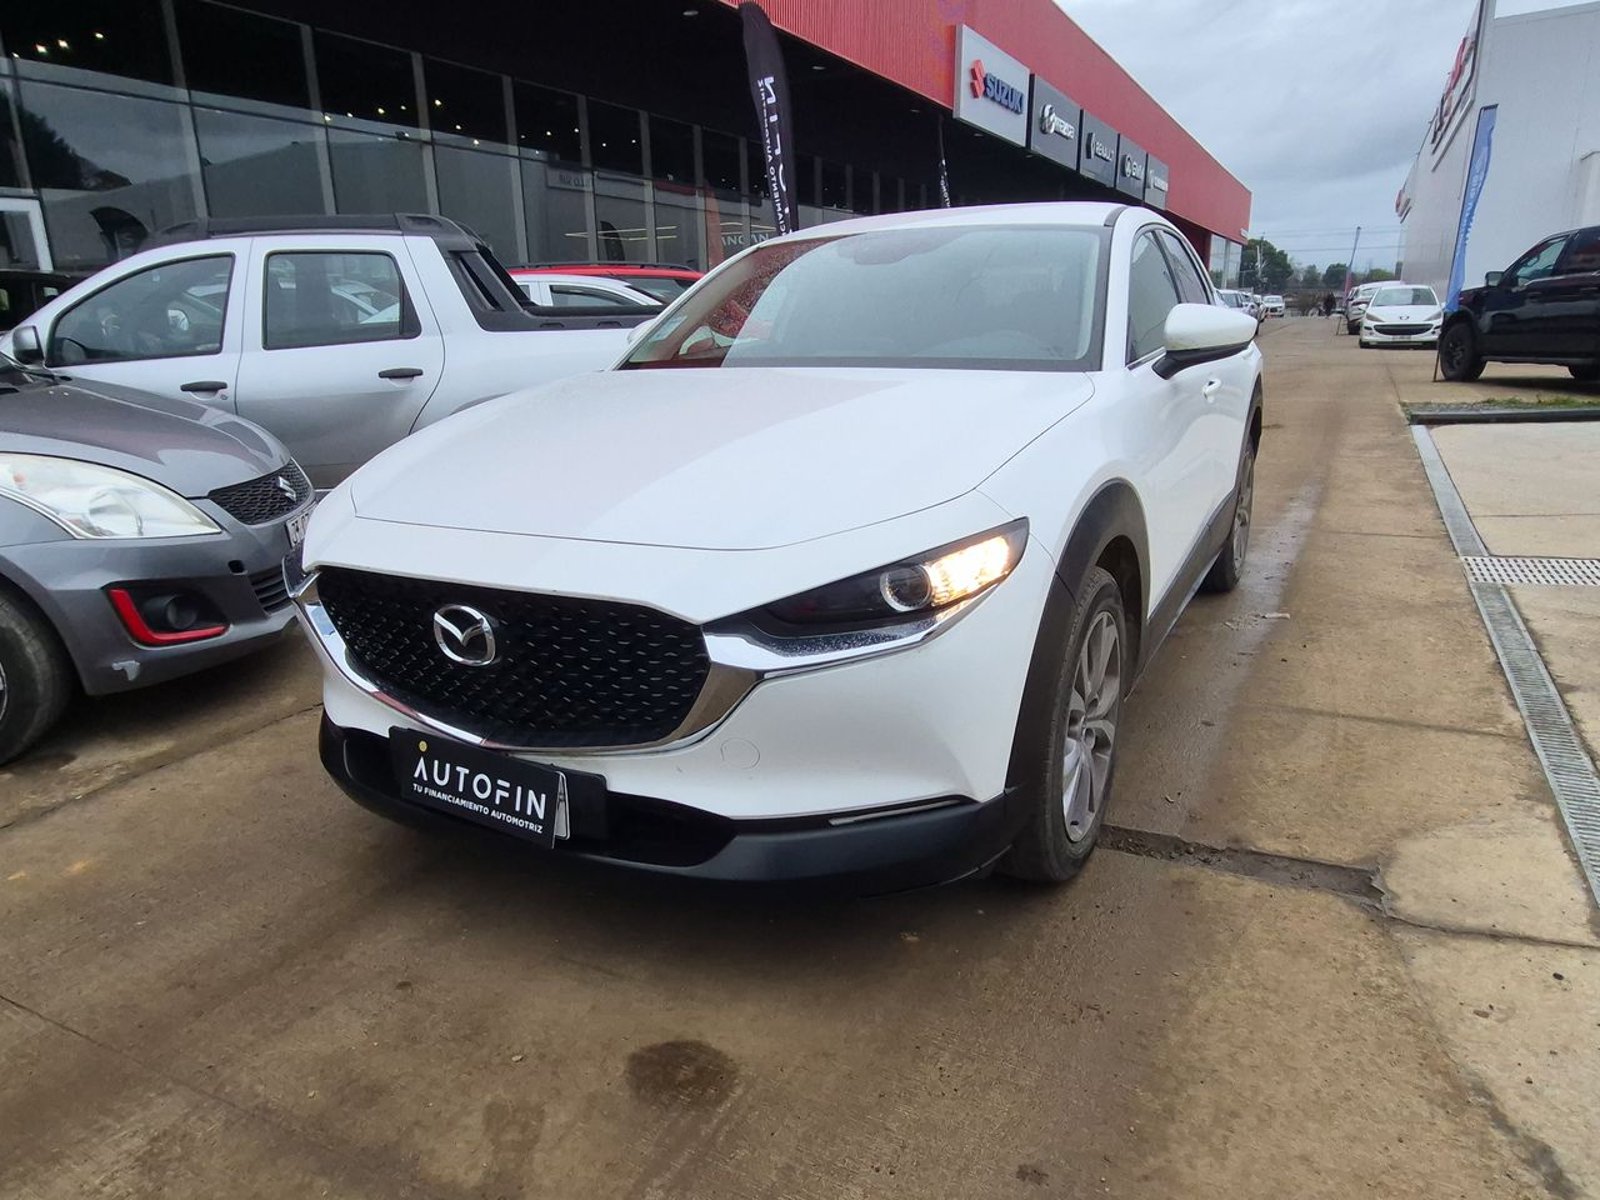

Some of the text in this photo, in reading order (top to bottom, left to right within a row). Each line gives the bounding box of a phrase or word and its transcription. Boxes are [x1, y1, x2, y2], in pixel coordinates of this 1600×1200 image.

[985, 73, 1024, 114] SUZUKI
[413, 756, 546, 820] AUTOFIN
[413, 783, 543, 834] TU FINANCIAMIENTO AUTOMOTRIZ
